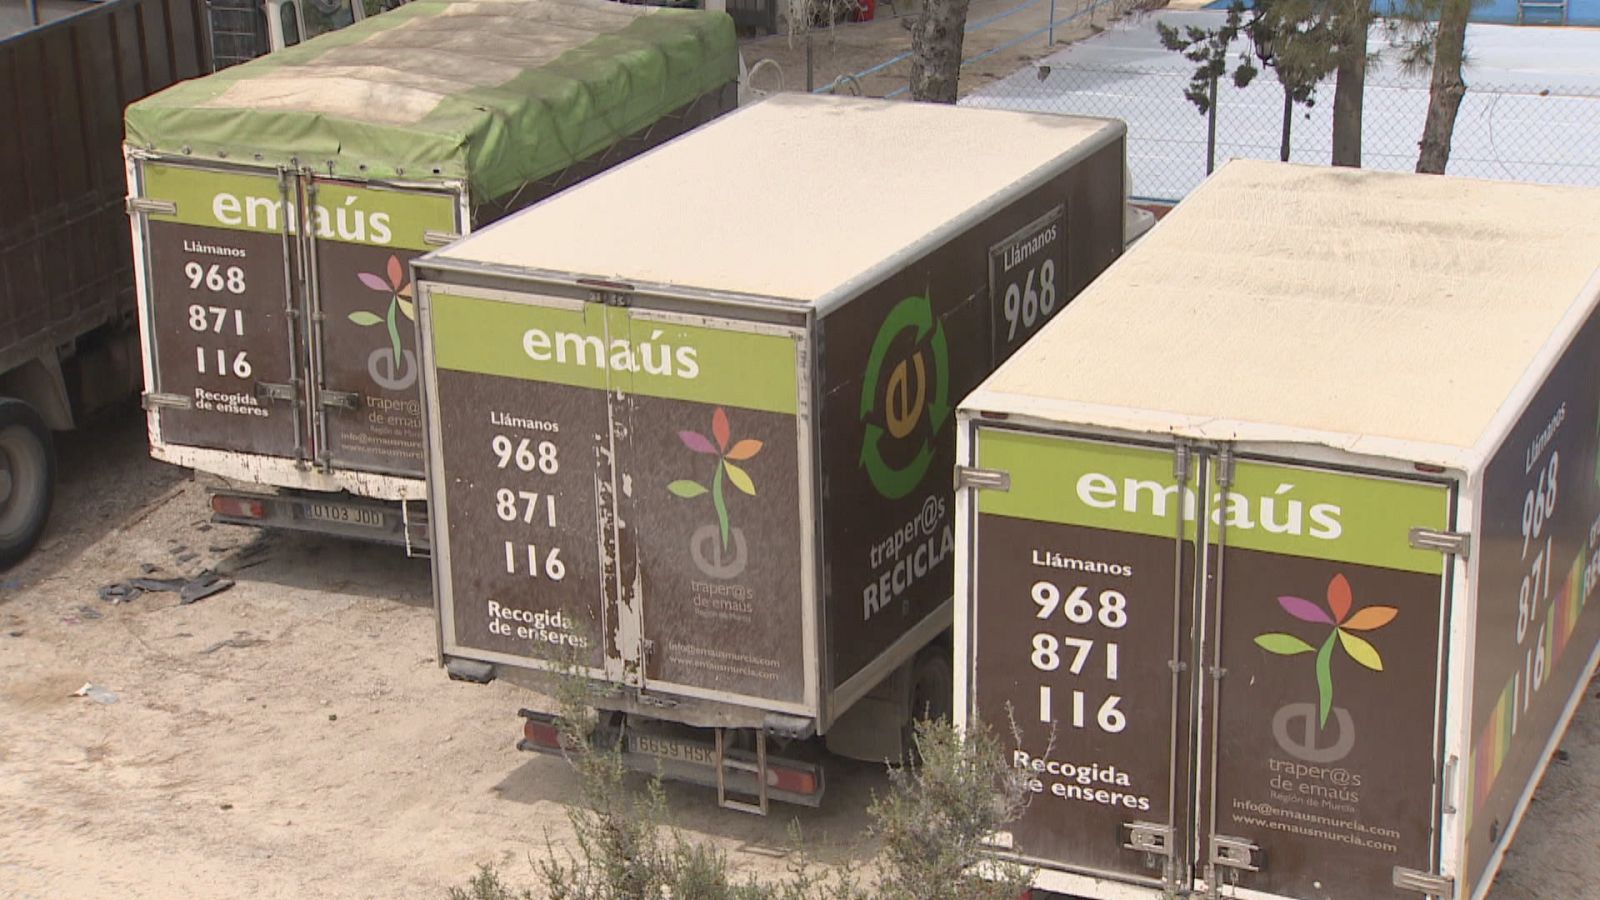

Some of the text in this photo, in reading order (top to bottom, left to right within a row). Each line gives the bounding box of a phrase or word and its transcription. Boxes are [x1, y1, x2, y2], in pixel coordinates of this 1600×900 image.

[212, 192, 392, 244] emaús
[184, 240, 246, 257] Llámanos
[1004, 224, 1057, 272] Llámanos
[184, 262, 246, 294] 968
[189, 304, 245, 336] 871
[1004, 259, 1056, 342] 968
[196, 347, 252, 378] 116
[522, 327, 699, 379] emaús
[195, 387, 258, 406] Recogida
[196, 400, 269, 417] de enseres
[366, 396, 421, 416] traper@
[369, 410, 422, 428] de emaú
[491, 411, 559, 433] Llámanos
[1525, 401, 1566, 476] Llámanos
[492, 435, 558, 475] 968
[496, 488, 556, 527] 871
[1076, 472, 1342, 540] emaús
[1522, 451, 1559, 561] 968
[870, 495, 945, 569] traper@s
[504, 541, 566, 581] 116
[1032, 549, 1133, 577] Llámanos
[691, 581, 753, 601] traper@s
[693, 596, 708, 608] de
[1031, 581, 1128, 629] 968
[1517, 536, 1552, 644] 871
[487, 600, 572, 629] Recogida
[490, 618, 588, 648] de enseres
[1031, 633, 1118, 680] 871
[1512, 622, 1544, 736] 116
[1040, 686, 1126, 733] 116
[1013, 750, 1131, 785] Recogida
[1269, 759, 1361, 787] traper@s
[1016, 772, 1150, 811] e enseres
[1270, 775, 1359, 803] de emaús
[1232, 813, 1397, 852] www.emausmurcia.com
[1233, 798, 1400, 839] info@emausmurcia.com
